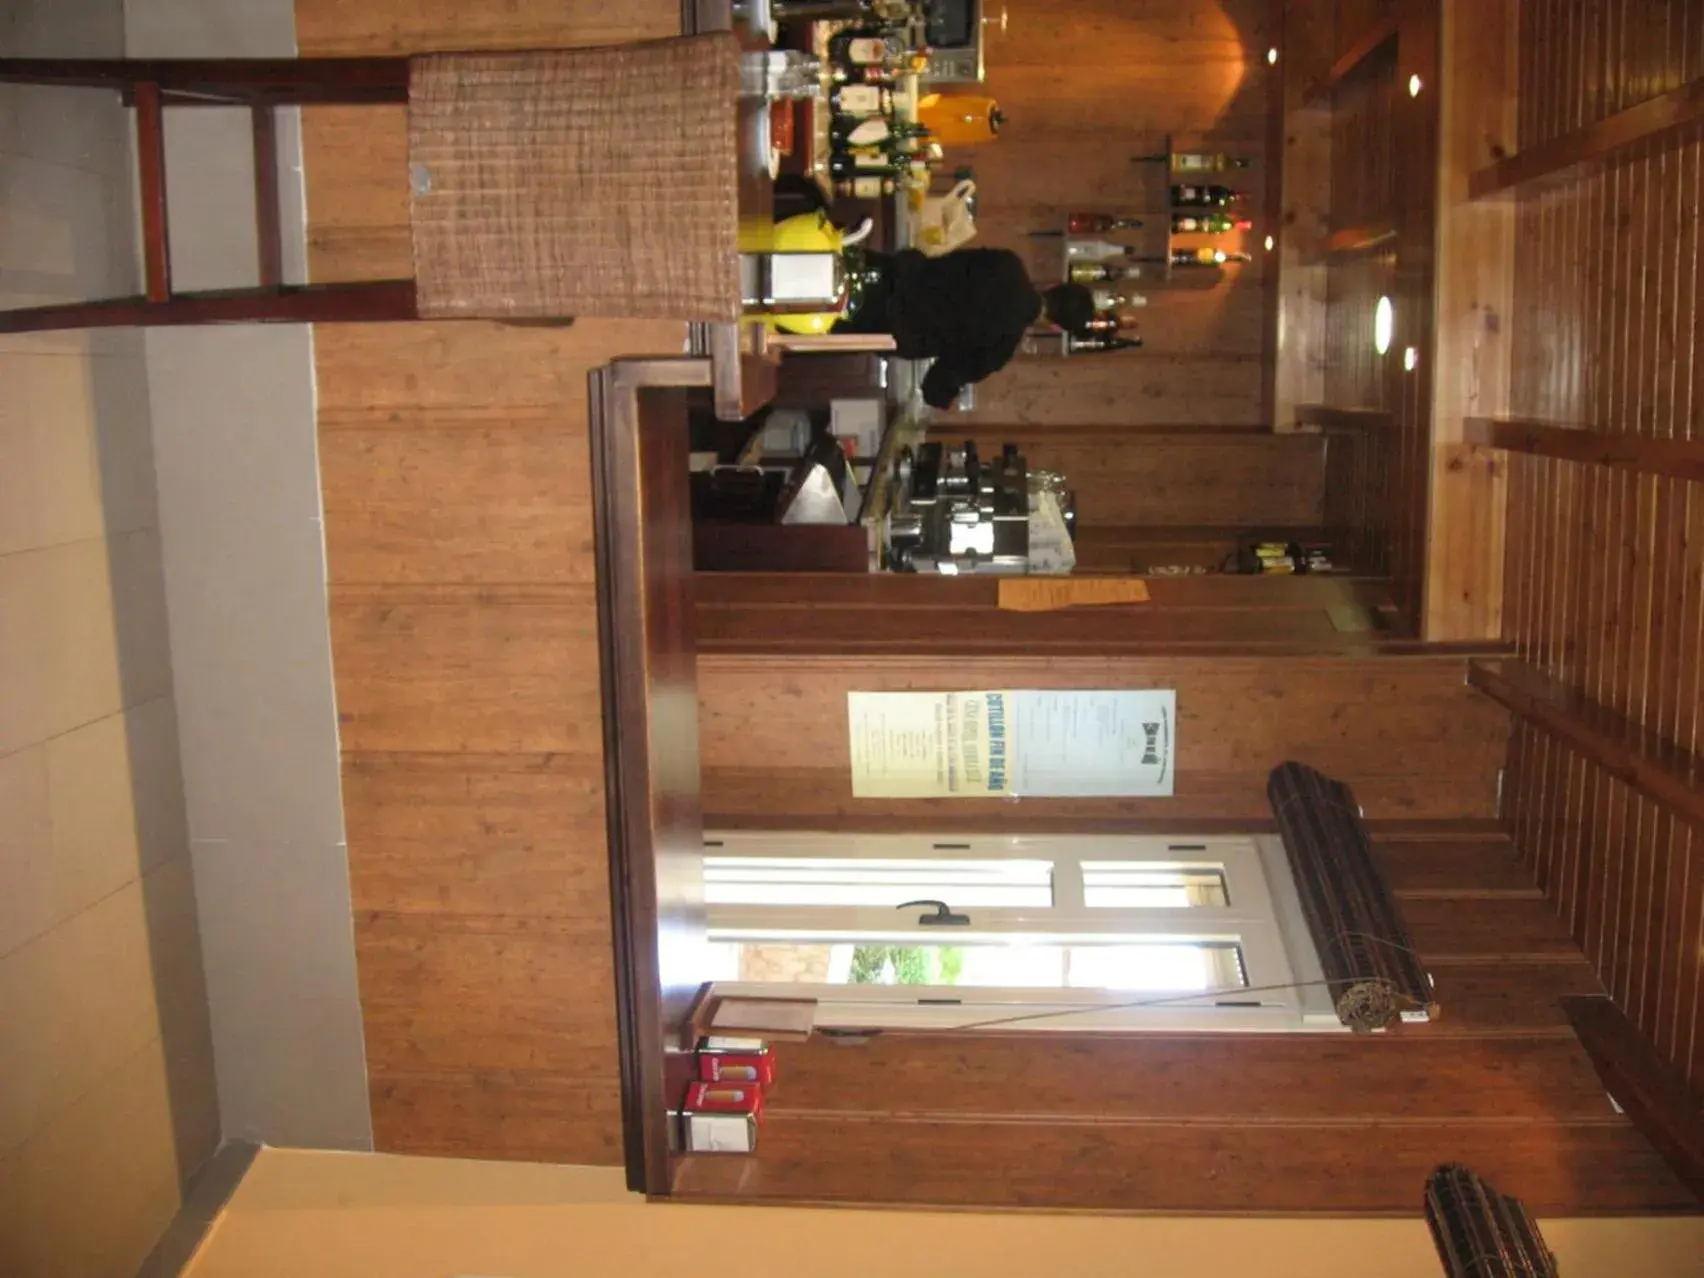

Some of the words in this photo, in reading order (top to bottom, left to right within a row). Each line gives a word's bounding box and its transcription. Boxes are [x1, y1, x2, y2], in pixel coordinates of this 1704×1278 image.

[989, 740, 1005, 755] FIN
[989, 757, 1006, 769] DE
[987, 771, 1008, 791] AÑO
